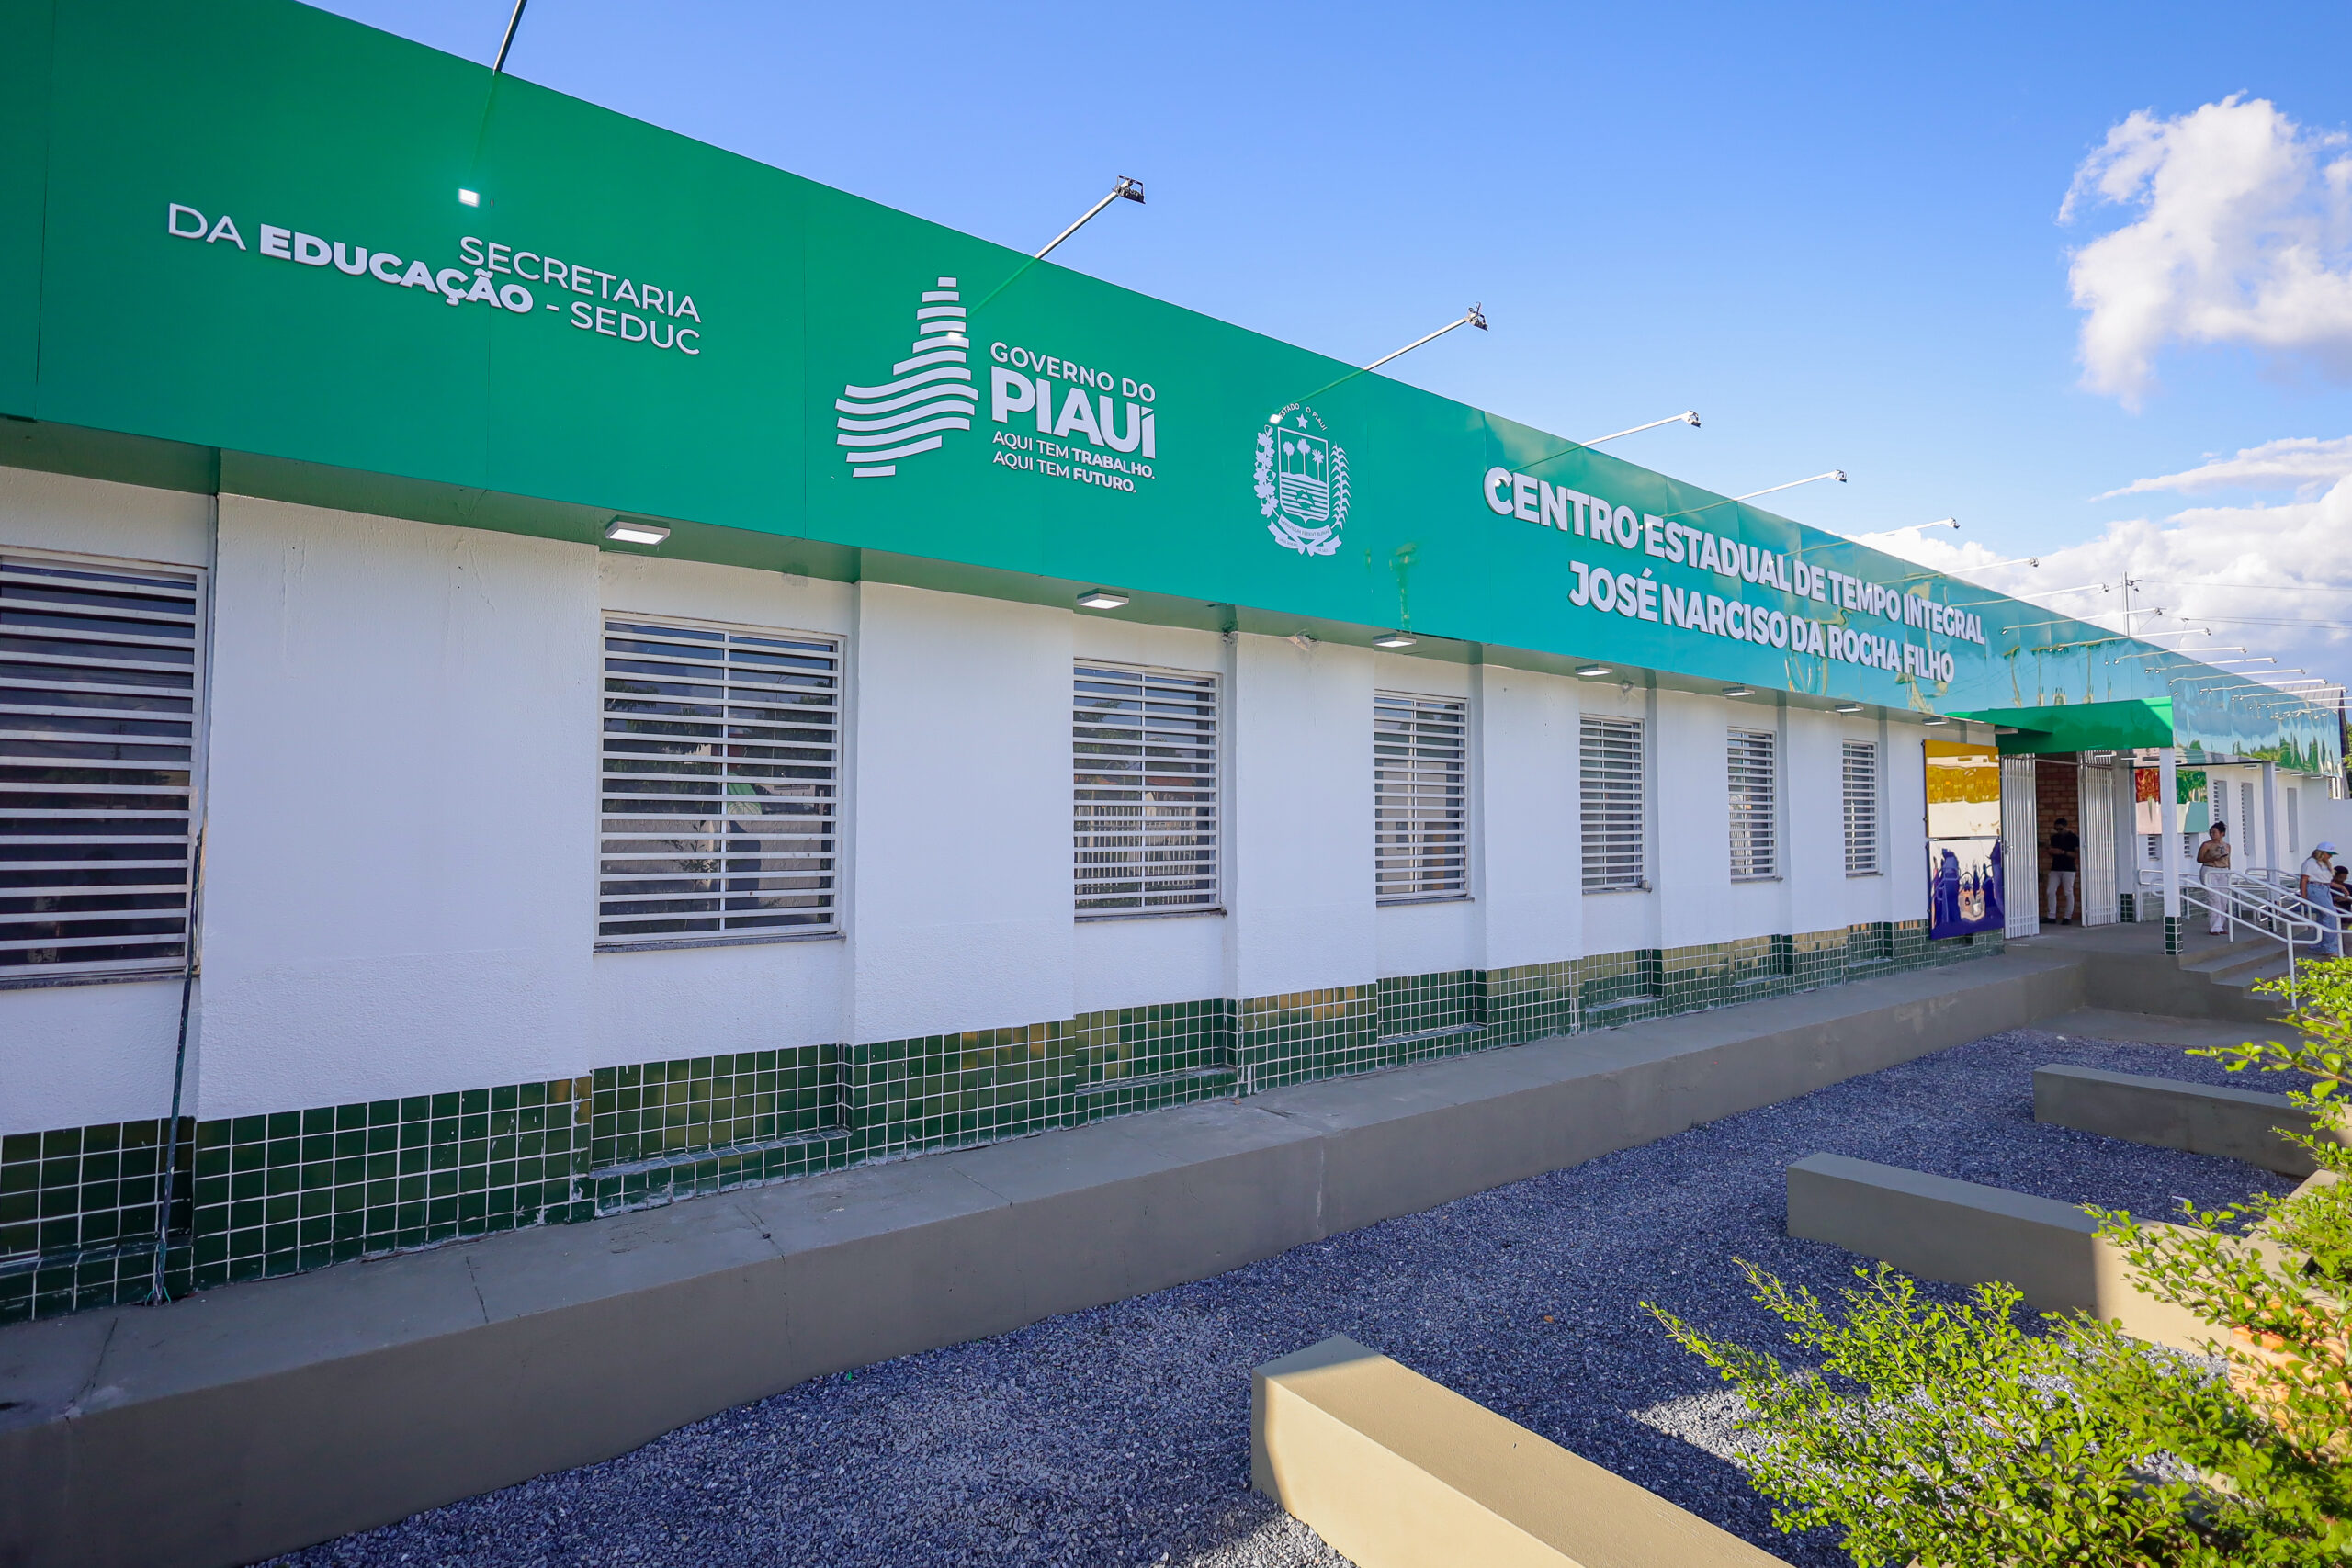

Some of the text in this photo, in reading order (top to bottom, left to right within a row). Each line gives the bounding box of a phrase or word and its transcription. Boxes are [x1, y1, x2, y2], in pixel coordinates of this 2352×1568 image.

[168, 202, 247, 251] DA
[260, 223, 534, 314] EDUCAÇÃO
[570, 301, 700, 355] SEDUC
[459, 236, 701, 323] SECRETARIA
[990, 342, 1156, 403] GOVERNO DO
[990, 366, 1156, 459] PIAUÍ
[992, 430, 1156, 479] AQUI TEM TRABALHO.
[992, 451, 1136, 493] AQUI TEM FUTURO.
[1483, 466, 1985, 645] CENTRO ESTADUAL DE TEMPO INTEGRAL
[1569, 560, 1955, 683] JOSÉ NARCISO DA ROCHA FILHO
